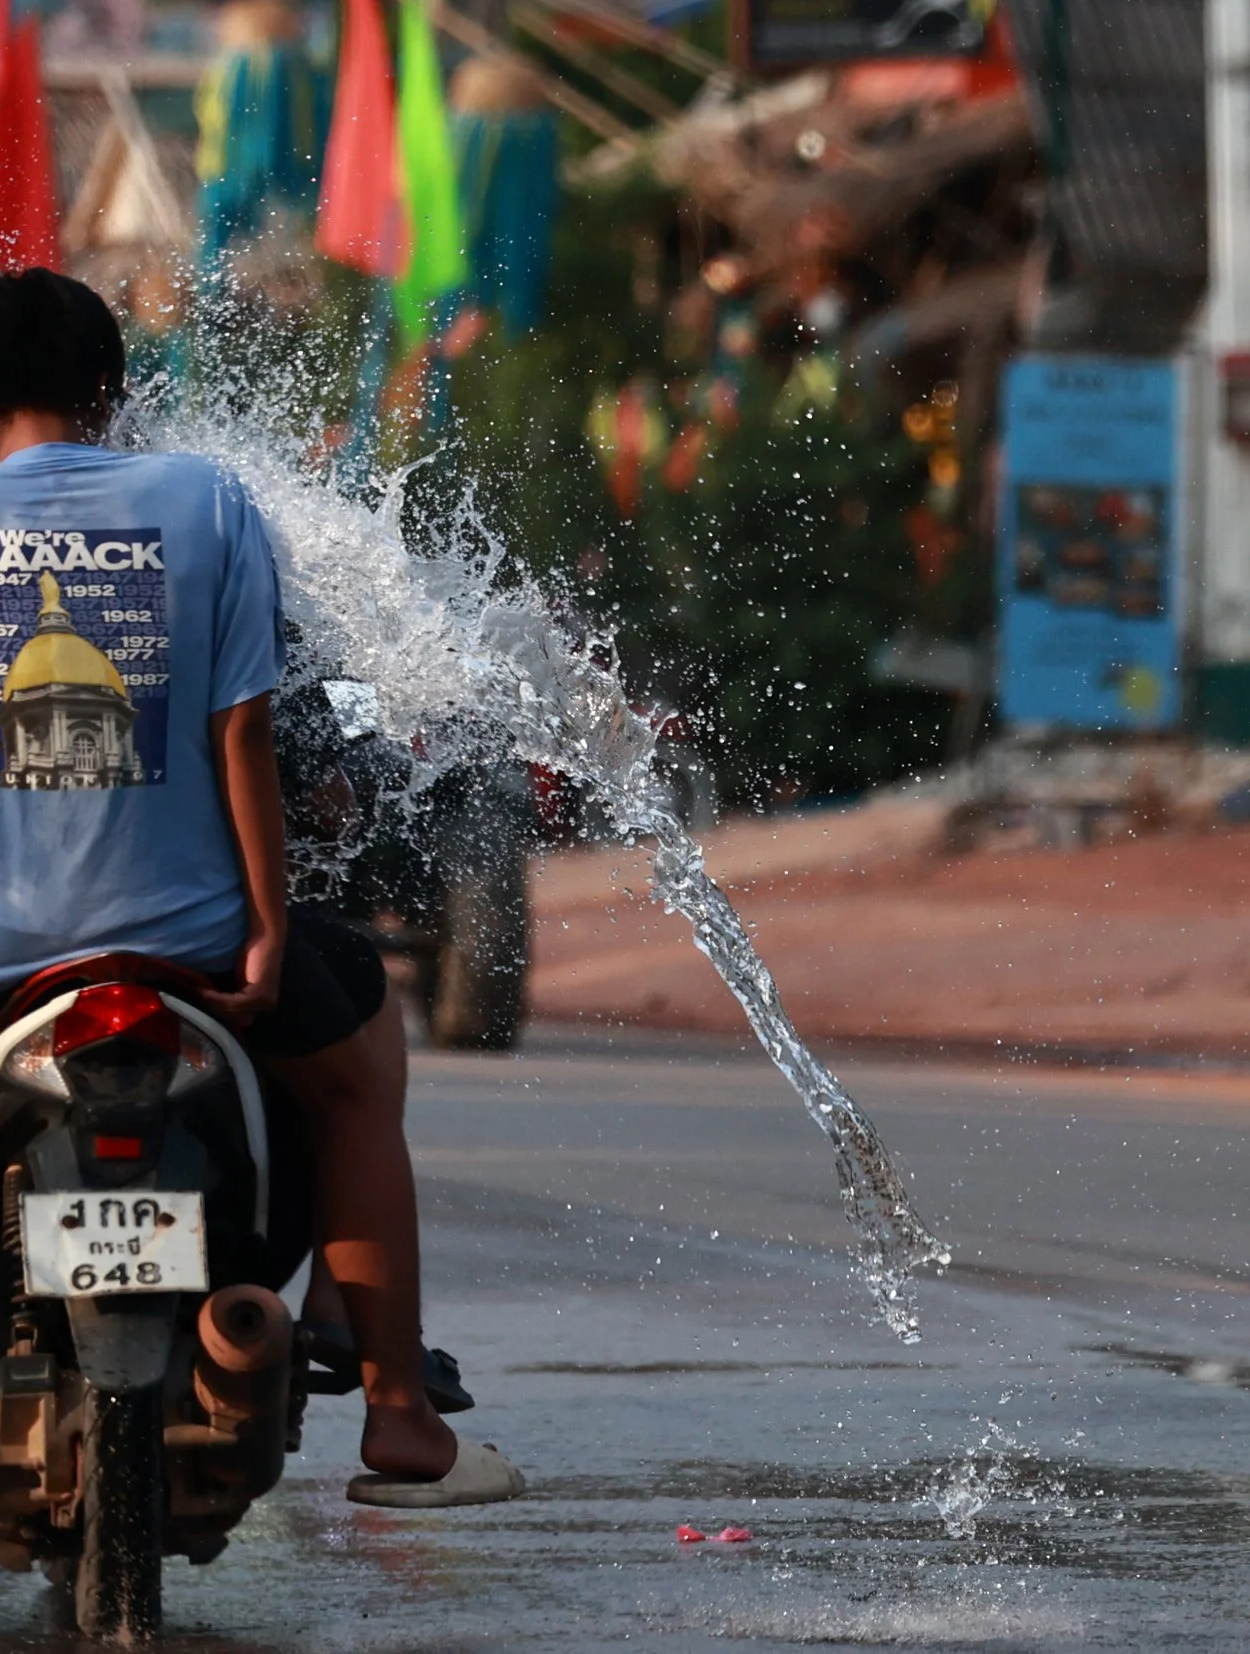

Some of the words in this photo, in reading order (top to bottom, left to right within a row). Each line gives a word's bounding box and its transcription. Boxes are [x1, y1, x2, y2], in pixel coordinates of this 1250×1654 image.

[64, 584, 116, 598] 1952
[101, 610, 153, 623] 1962
[120, 636, 170, 648] 1972
[105, 649, 155, 661] 1977
[121, 674, 170, 686] 1987
[71, 1262, 163, 1290] 648
